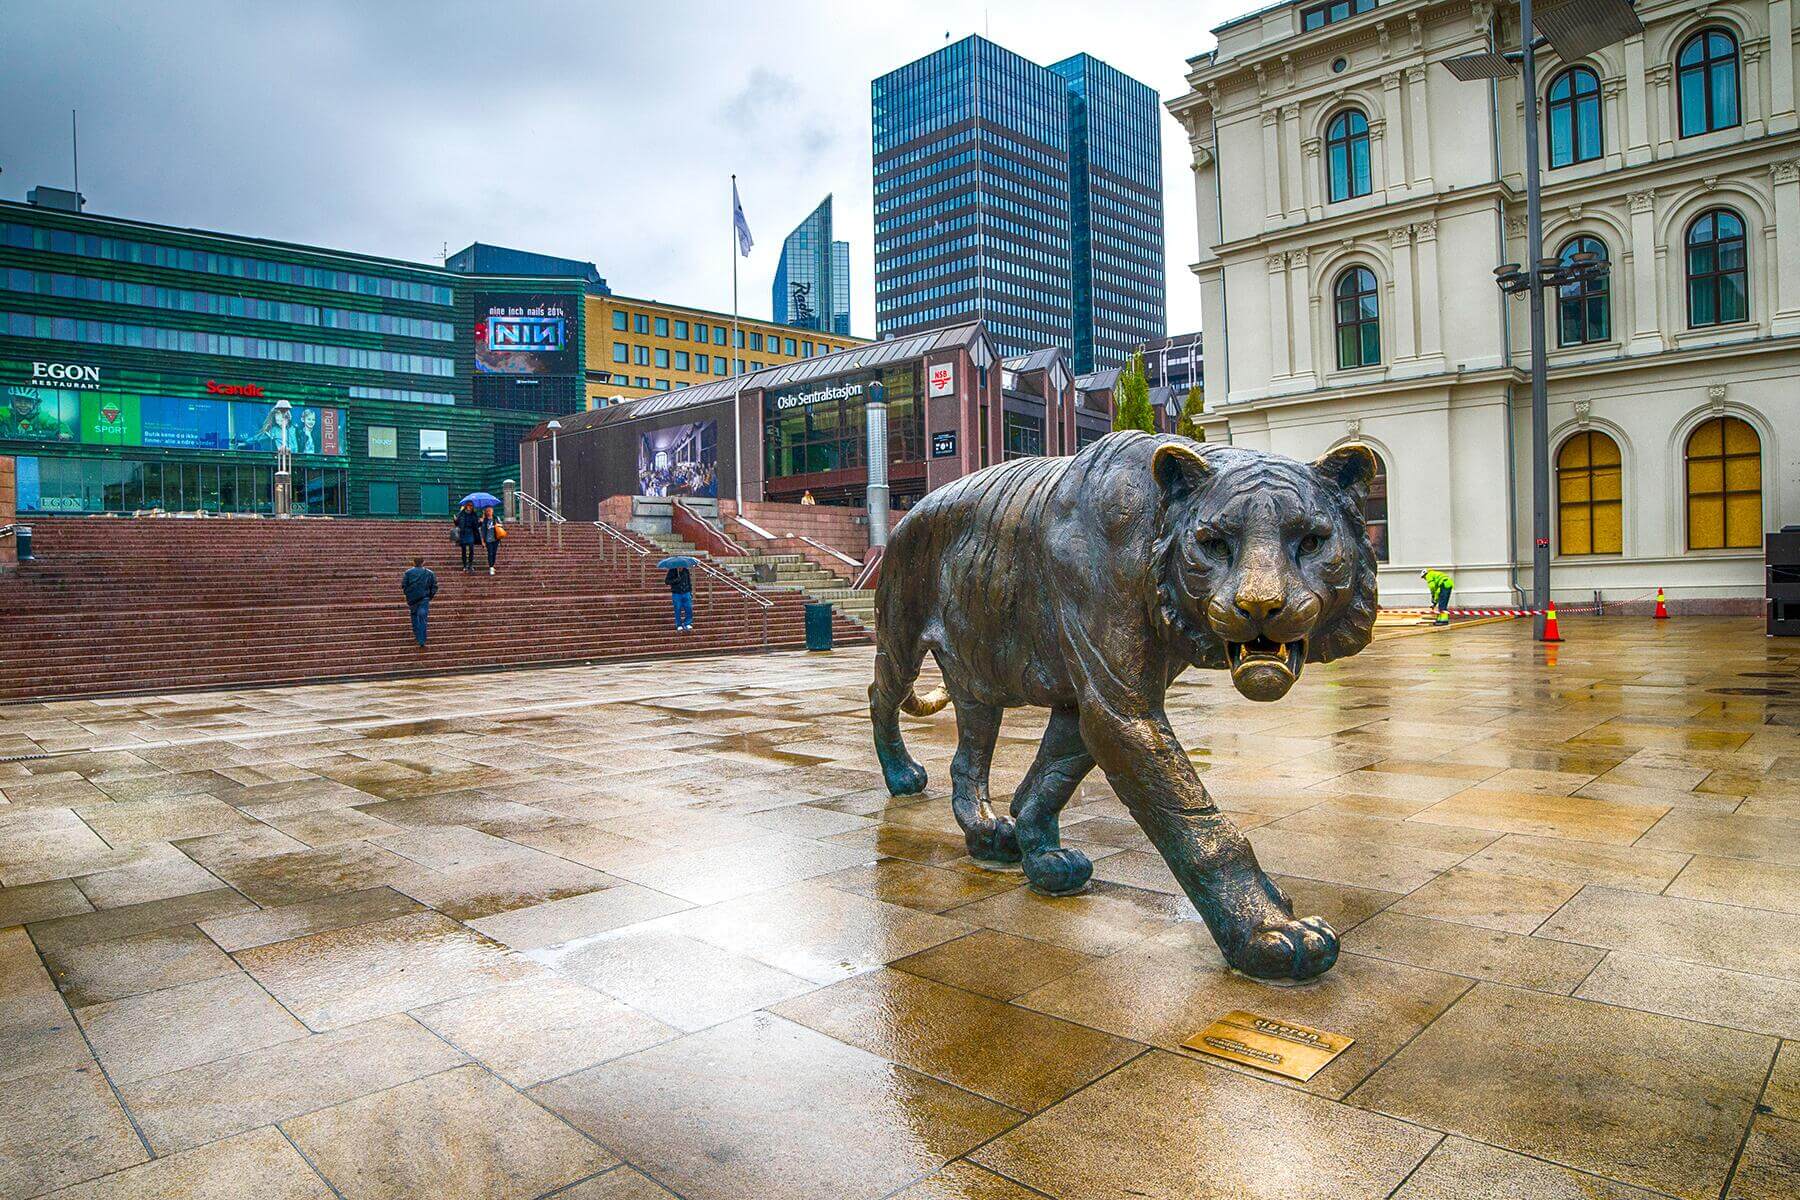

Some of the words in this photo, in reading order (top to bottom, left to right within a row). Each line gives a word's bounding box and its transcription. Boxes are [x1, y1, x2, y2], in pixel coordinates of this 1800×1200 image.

[489, 307, 505, 316] nine
[508, 307, 524, 315] inch
[527, 307, 545, 316] nails
[547, 307, 564, 317] 2014
[32, 361, 101, 382] EGON
[934, 369, 948, 379] NSB
[31, 379, 101, 390] RESTAURANT
[206, 380, 265, 398] Scandic
[777, 394, 797, 410] Oslo
[797, 383, 862, 406] Sentralstasjon
[94, 425, 128, 434] SPORT
[324, 411, 334, 440] name
